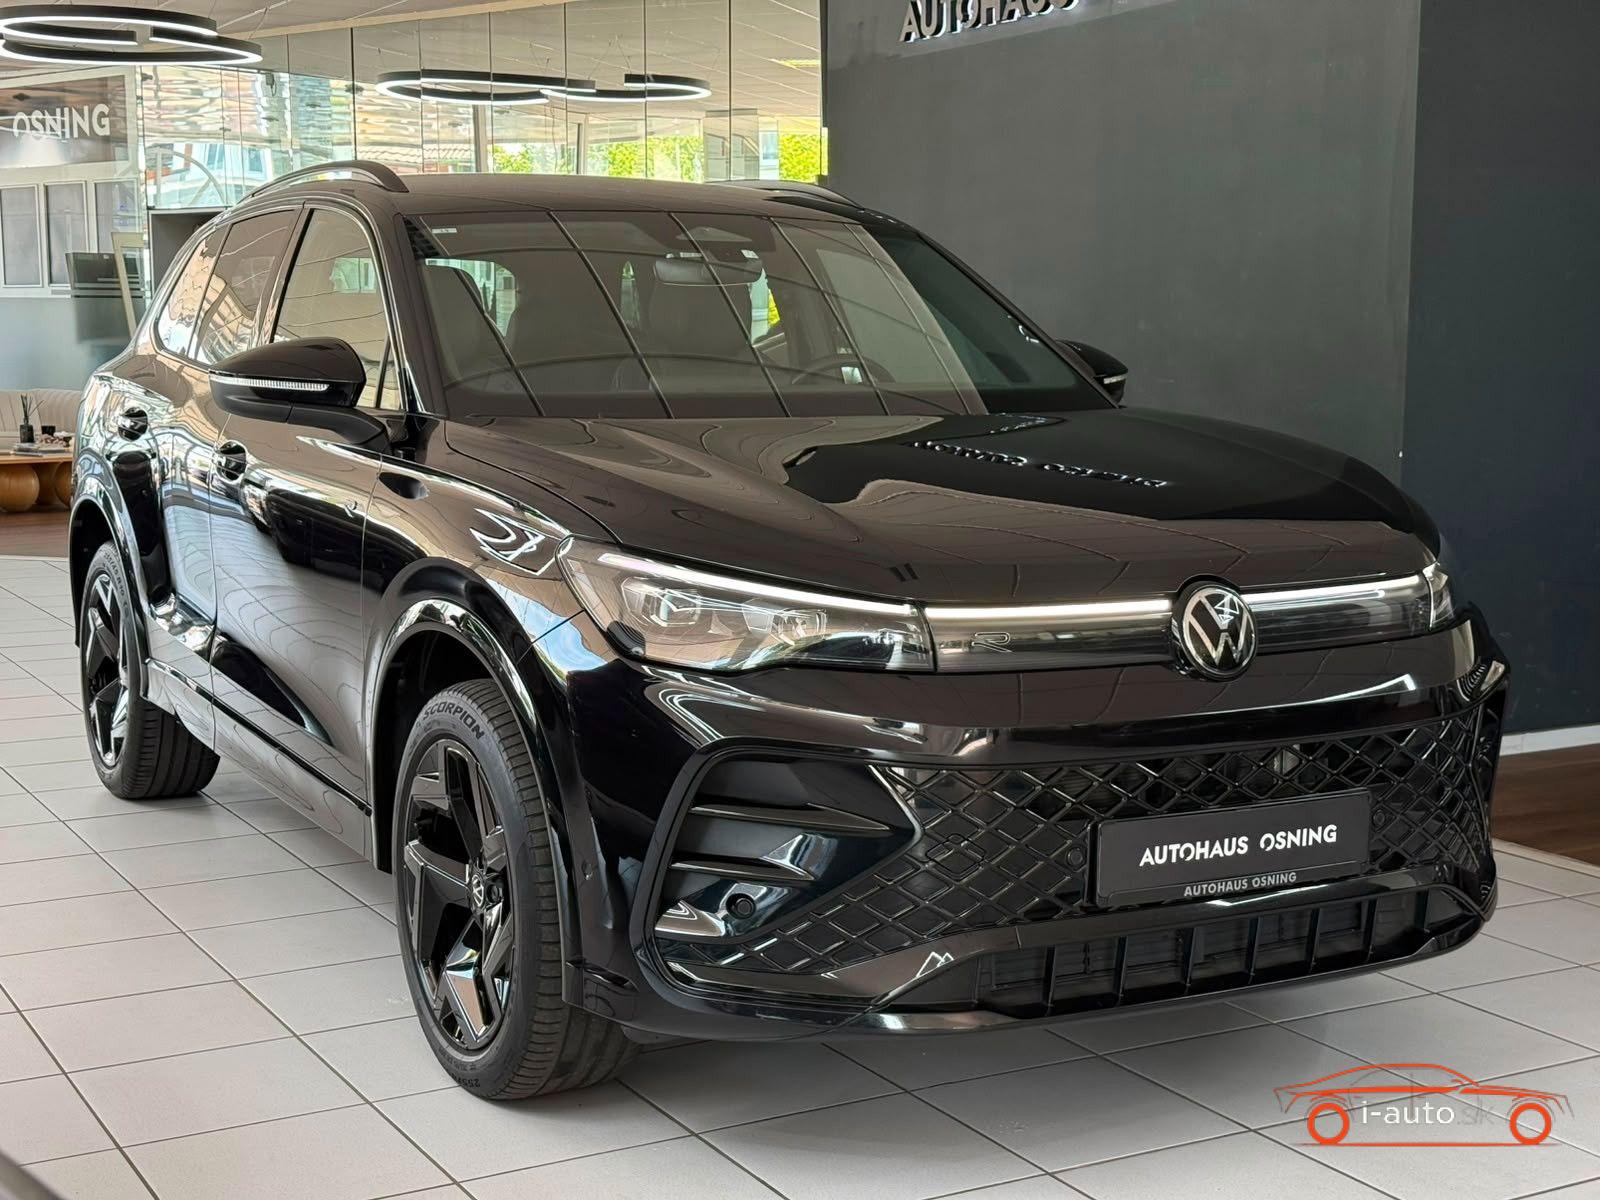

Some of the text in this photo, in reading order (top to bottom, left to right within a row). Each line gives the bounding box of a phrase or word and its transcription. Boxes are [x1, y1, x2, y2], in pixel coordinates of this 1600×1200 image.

[13, 103, 111, 139] OSNING
[971, 631, 1013, 653] R
[423, 701, 485, 740] SCORPION
[1139, 824, 1338, 867] AUTOHAUS OSNING
[1183, 872, 1298, 898] AUTOHAUS OSNING
